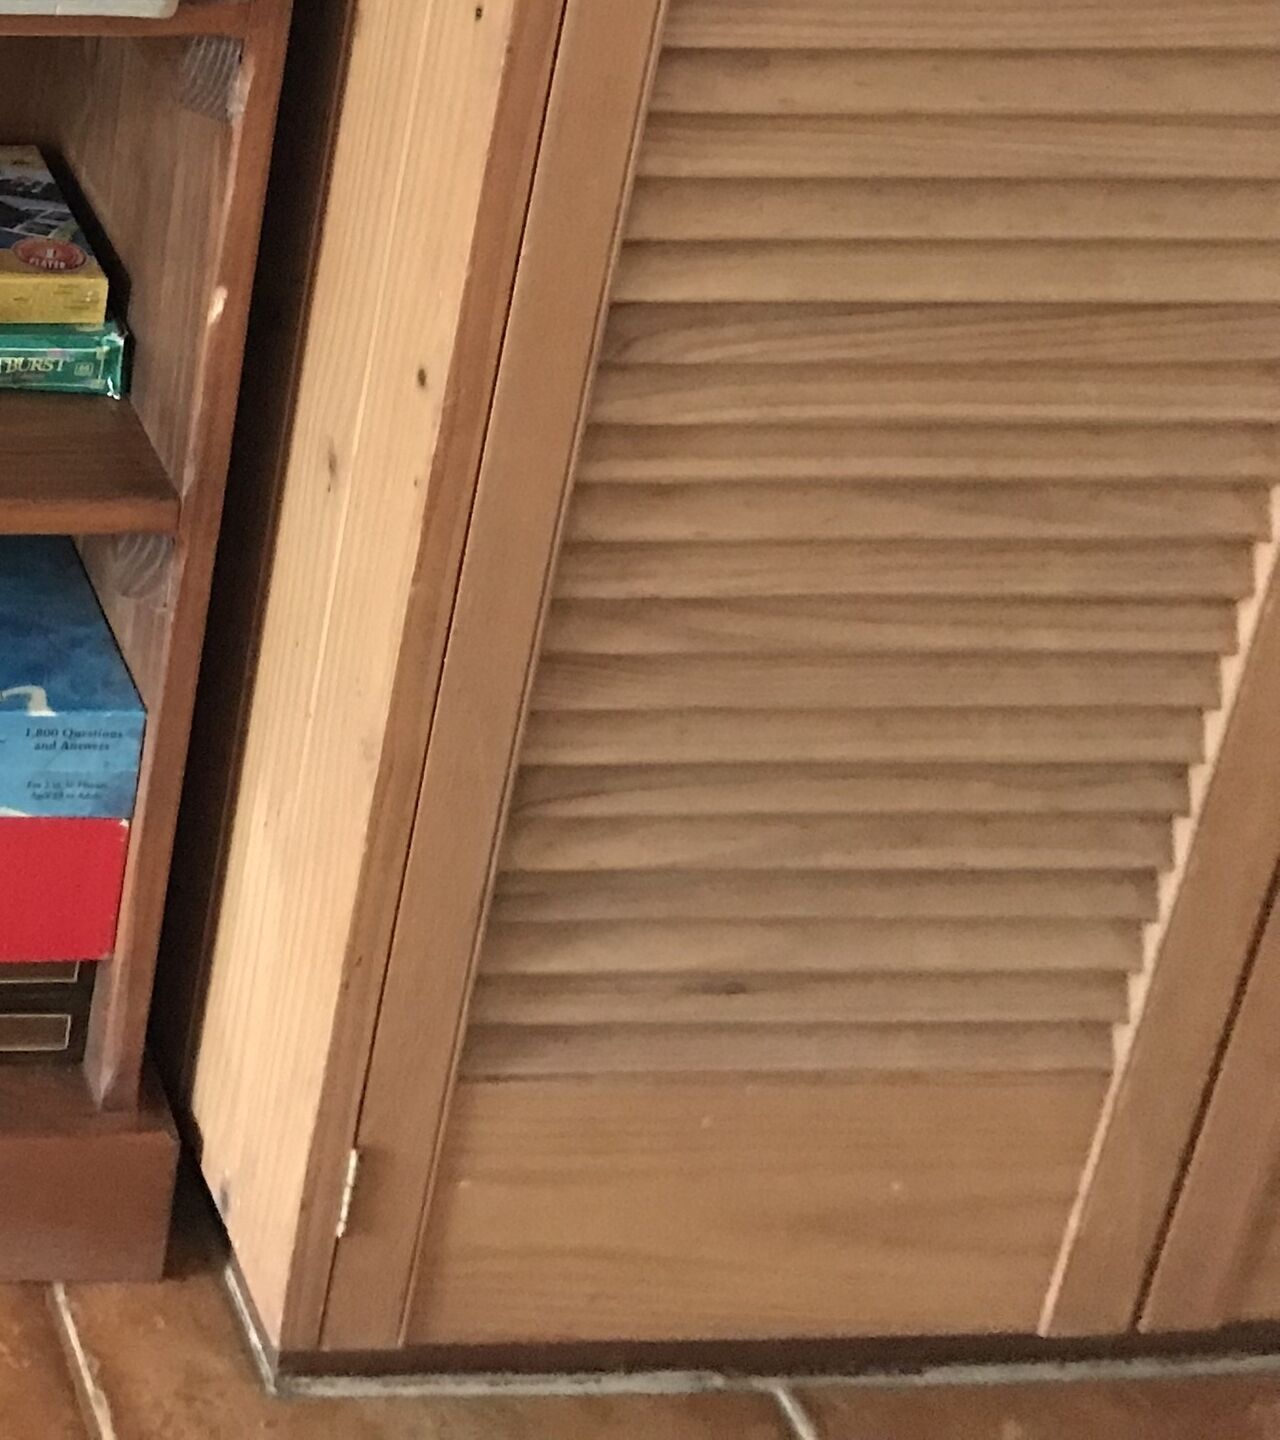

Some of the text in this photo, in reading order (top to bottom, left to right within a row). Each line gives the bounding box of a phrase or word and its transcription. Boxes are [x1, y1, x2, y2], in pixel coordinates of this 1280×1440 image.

[29, 258, 67, 270] PLAYER
[25, 727, 124, 740] 1,800 Questions
[33, 740, 110, 752] and Answers
